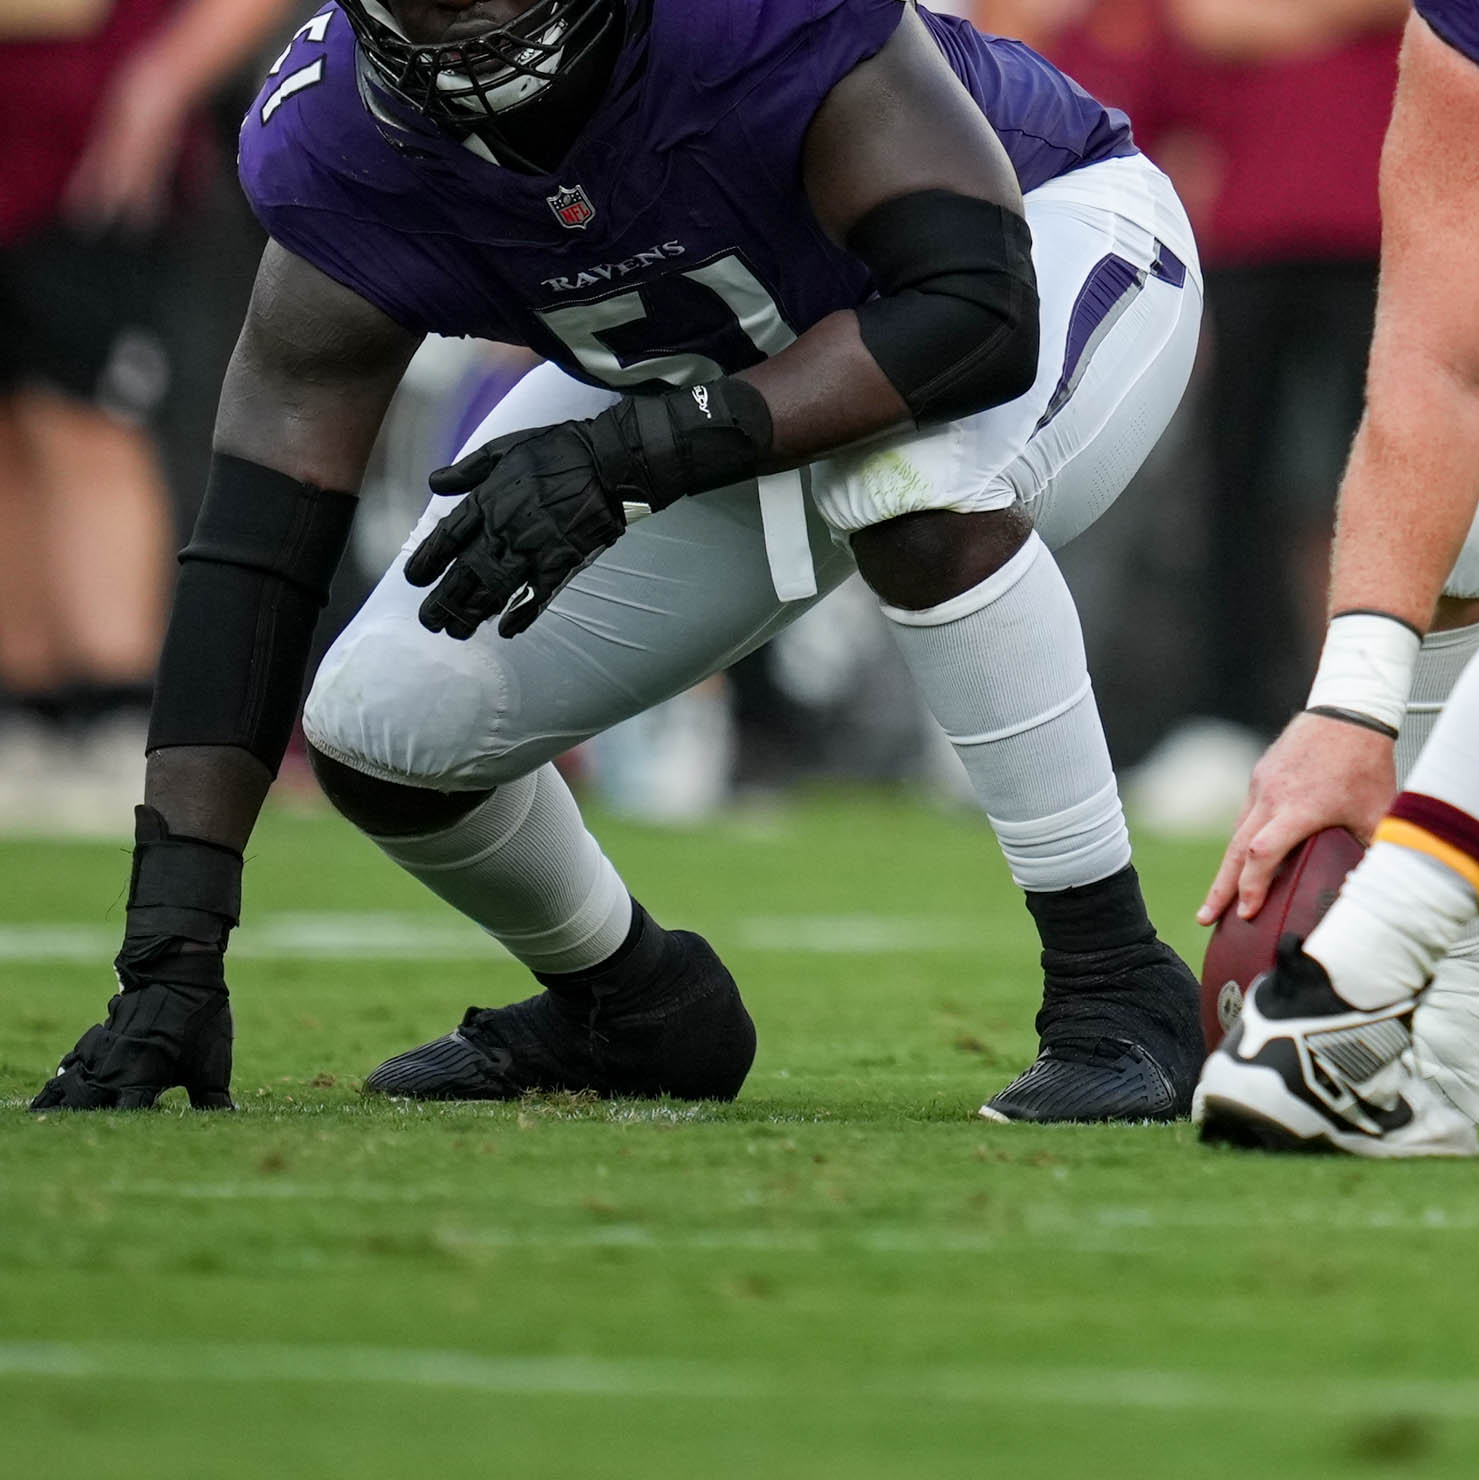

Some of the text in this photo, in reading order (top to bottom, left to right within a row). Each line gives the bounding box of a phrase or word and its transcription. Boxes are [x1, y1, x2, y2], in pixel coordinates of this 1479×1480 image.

[559, 202, 591, 224] NFL
[540, 239, 686, 293] RAVENS
[530, 250, 799, 388] 51
